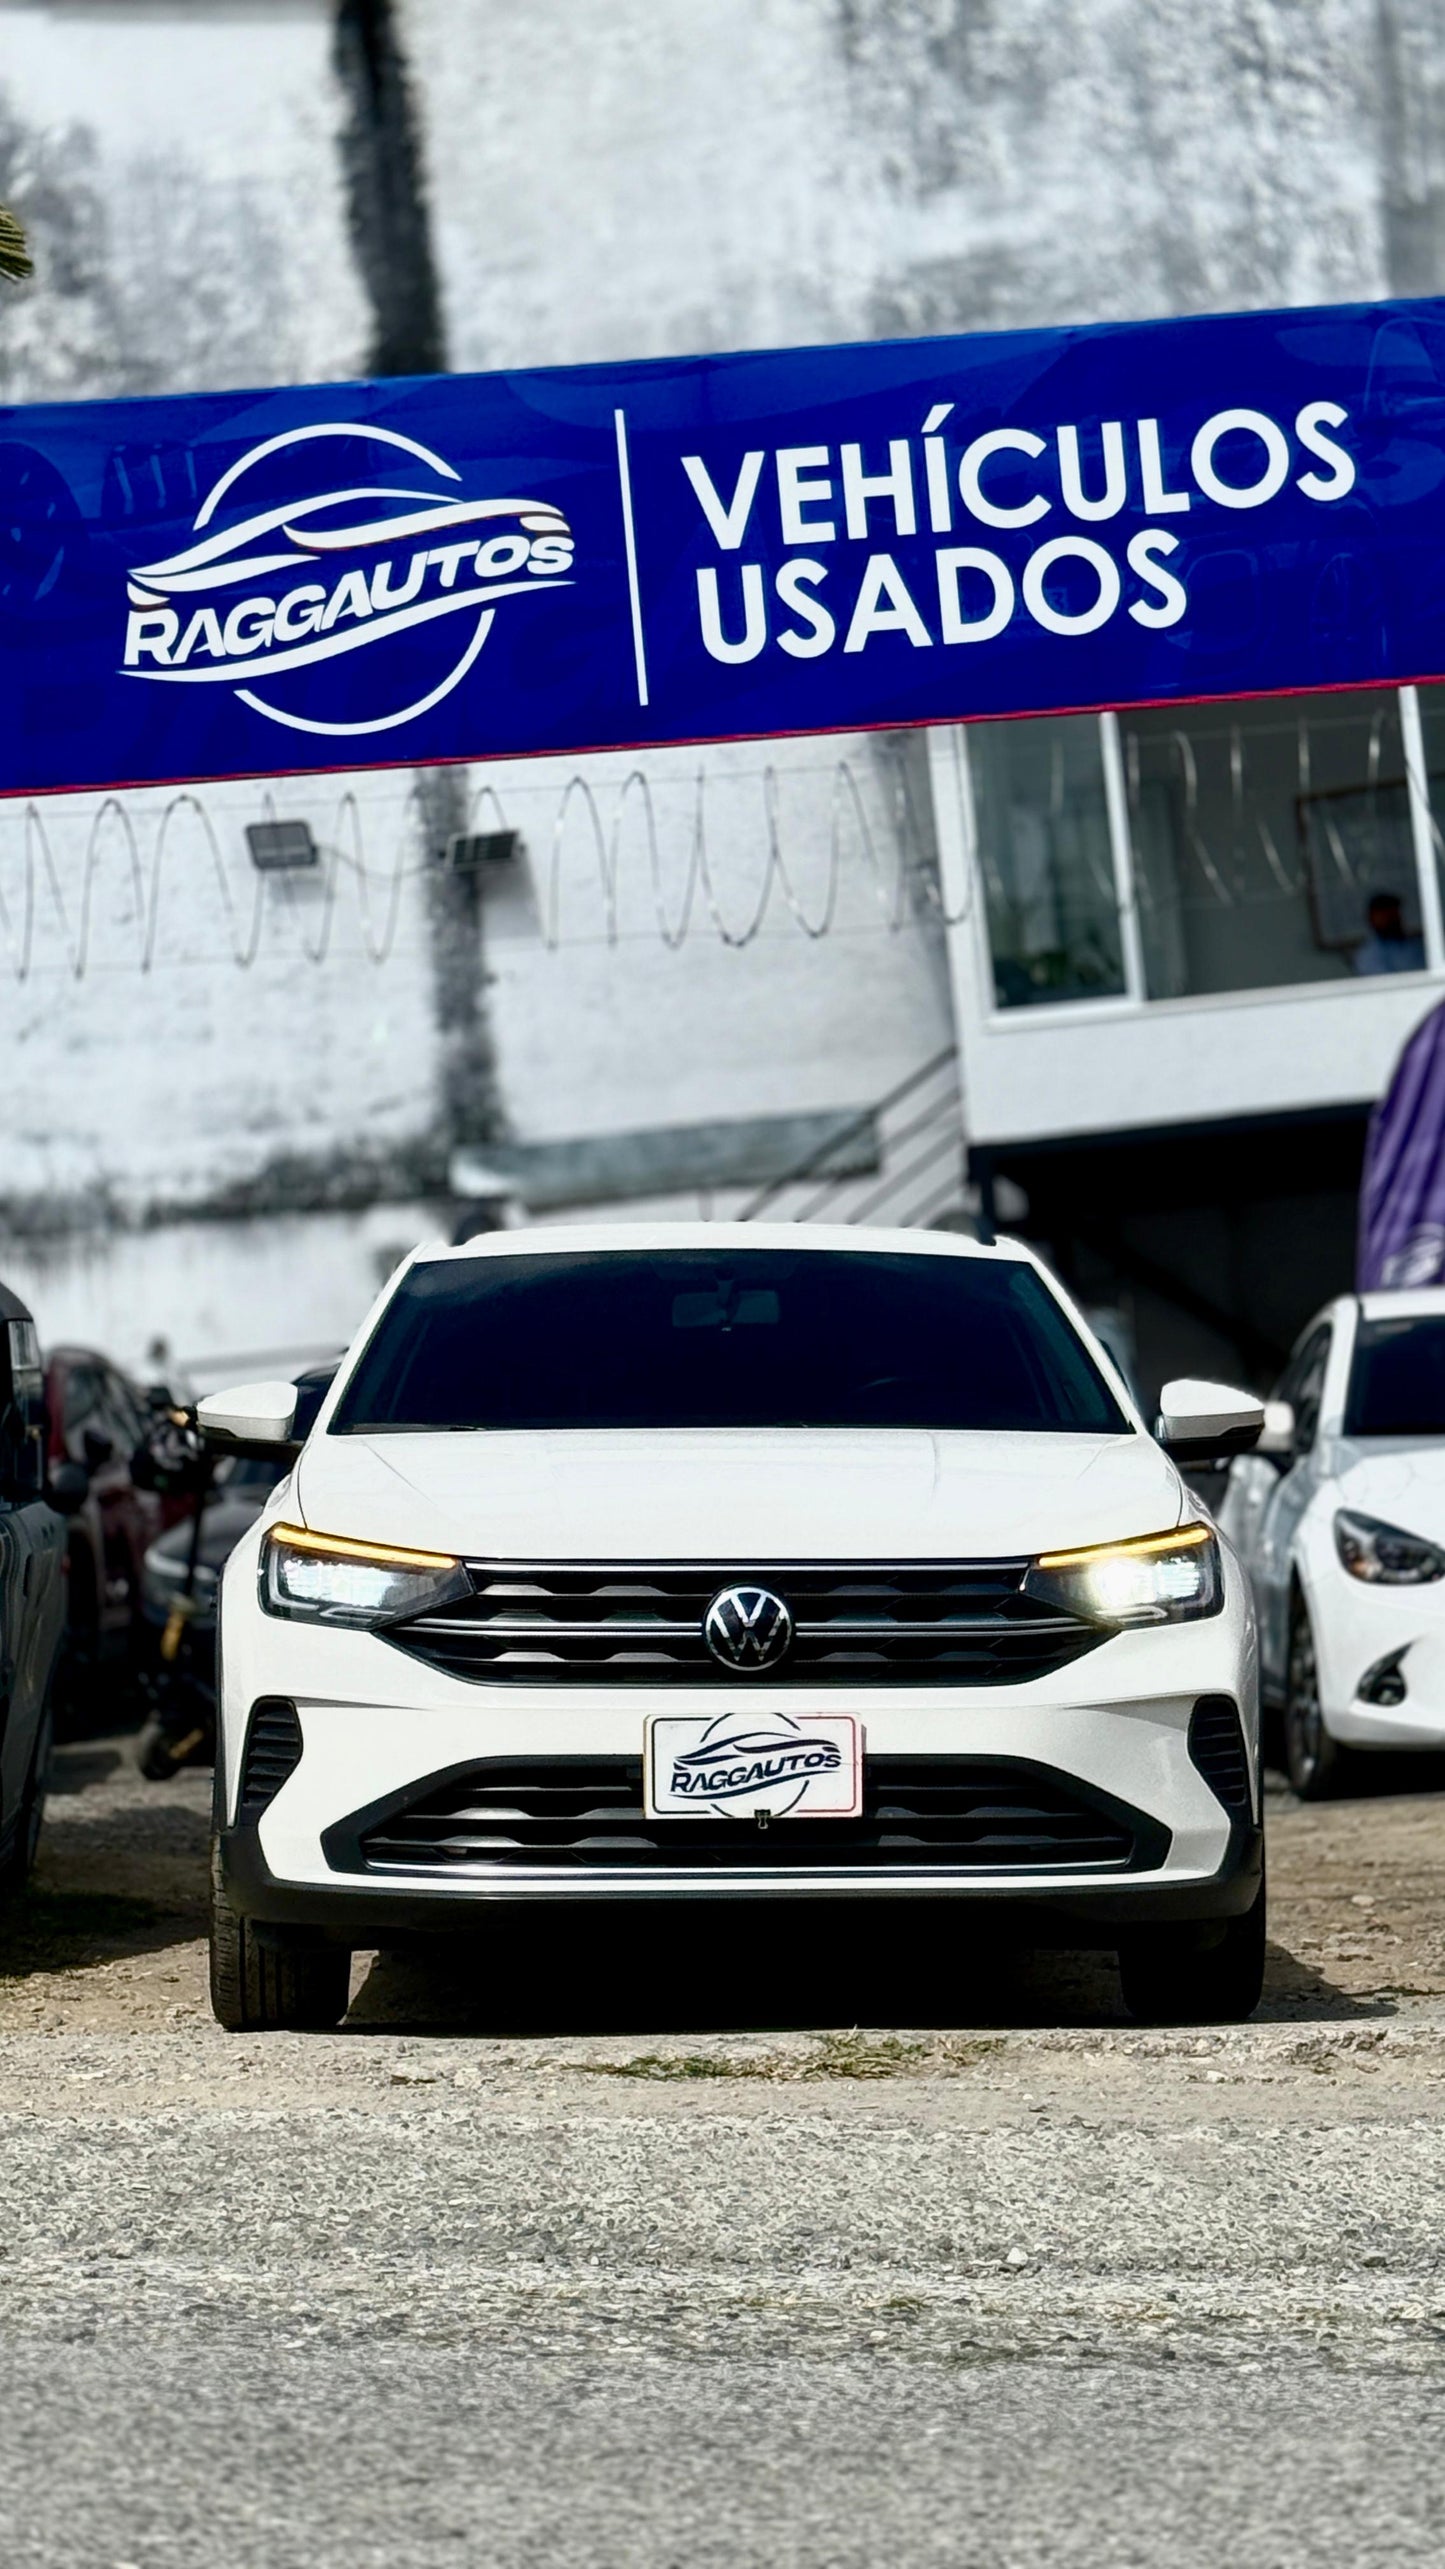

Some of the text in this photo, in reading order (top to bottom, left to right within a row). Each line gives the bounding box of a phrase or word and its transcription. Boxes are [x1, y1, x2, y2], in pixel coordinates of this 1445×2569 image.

[681, 402, 1355, 549] VEHÍCULOS
[124, 535, 574, 665] RAGGAUTOS
[696, 529, 1187, 664] USADOS
[671, 1753, 842, 1792] RAGGAUTOS
